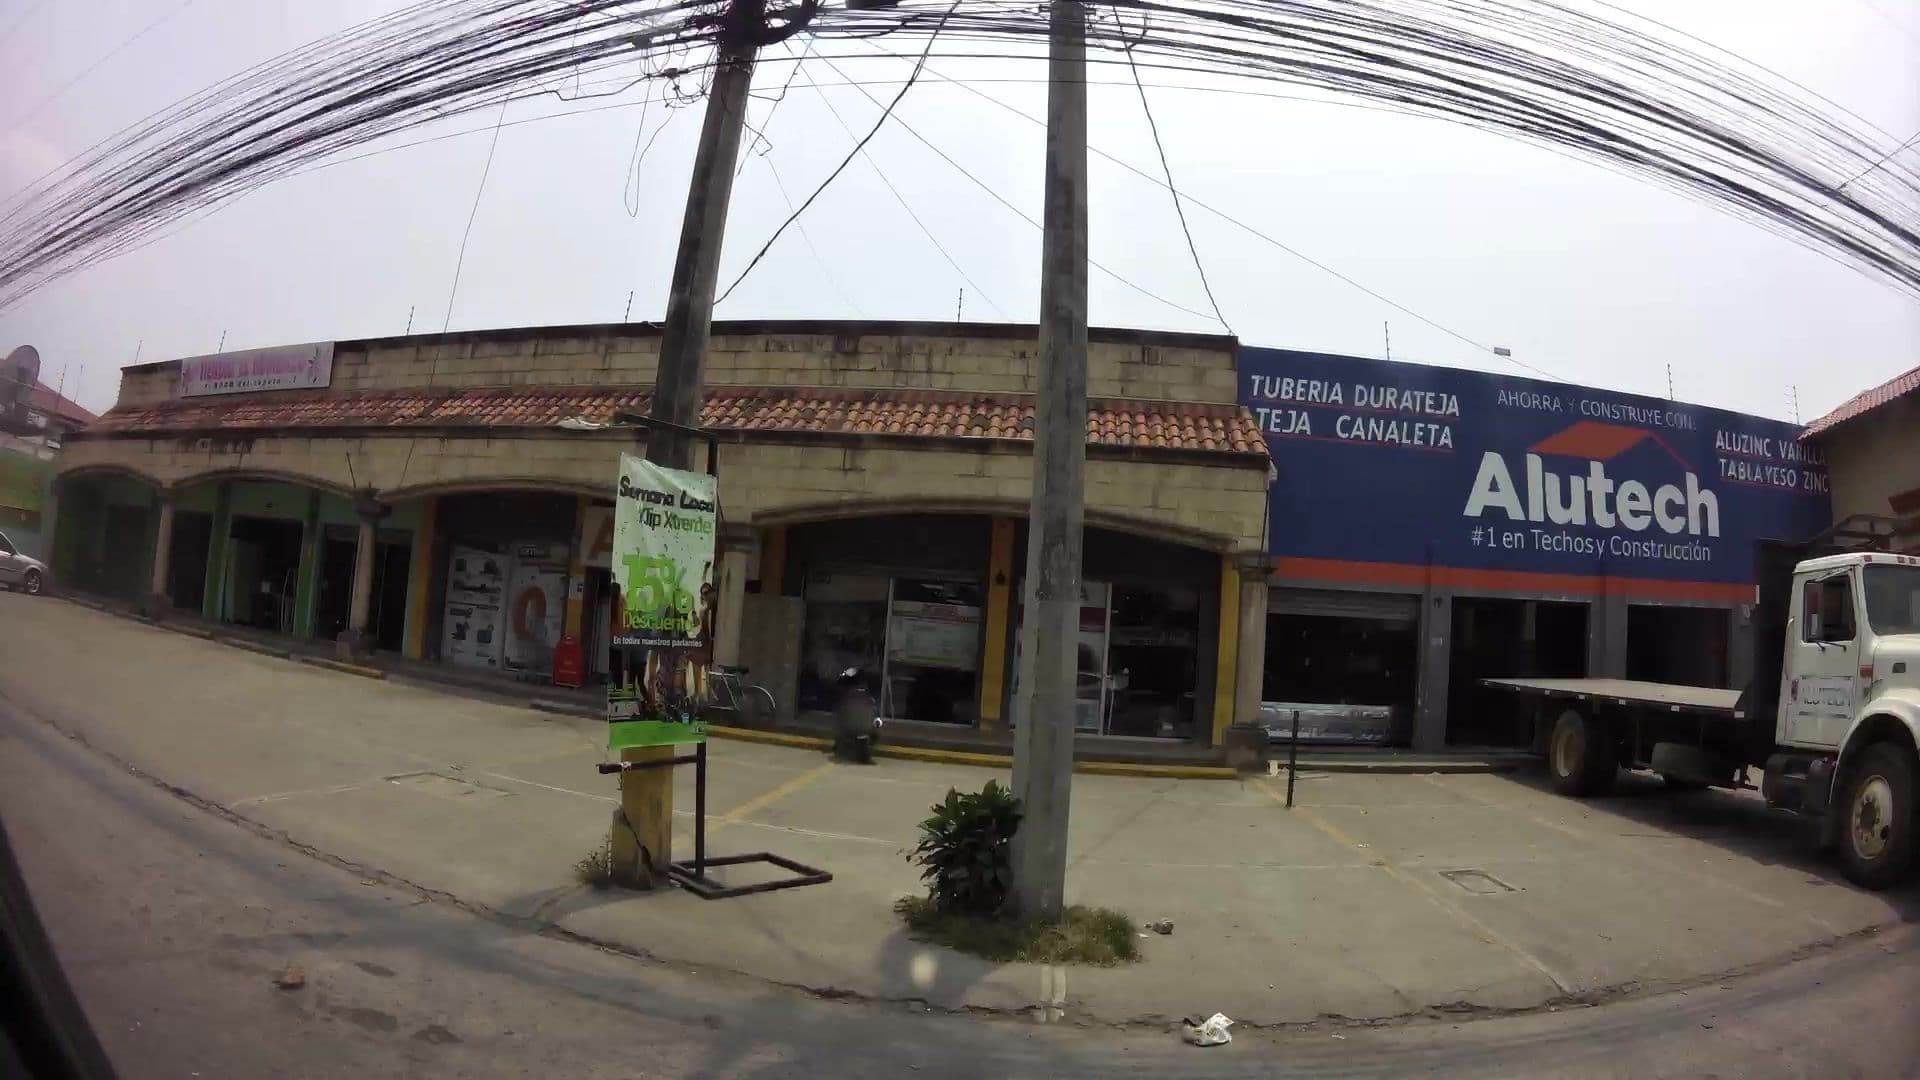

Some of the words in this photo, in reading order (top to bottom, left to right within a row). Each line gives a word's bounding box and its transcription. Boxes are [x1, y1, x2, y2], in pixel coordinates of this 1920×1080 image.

[1251, 375, 1344, 405] TUBERIA
[1354, 384, 1460, 417] DURATEJA
[1498, 389, 1563, 413] AHORRA
[1580, 399, 1662, 426] CONSTRUYE
[1256, 407, 1312, 436] TEJA
[1335, 415, 1453, 449] CANALETA
[1715, 430, 1772, 457] ALUZINC
[619, 475, 675, 507] Semana
[679, 490, 715, 513] Loca
[1463, 451, 1720, 538] Alutech
[1802, 471, 1829, 493] ZINC
[1471, 526, 1497, 549] #1
[1502, 531, 1525, 549] en
[1530, 529, 1594, 554] Techos
[1595, 537, 1606, 560] y
[1609, 536, 1711, 562] Construcción
[613, 635, 622, 645] En
[622, 636, 641, 646] todos
[641, 637, 671, 647] nuestros
[671, 639, 703, 649] parlantes
